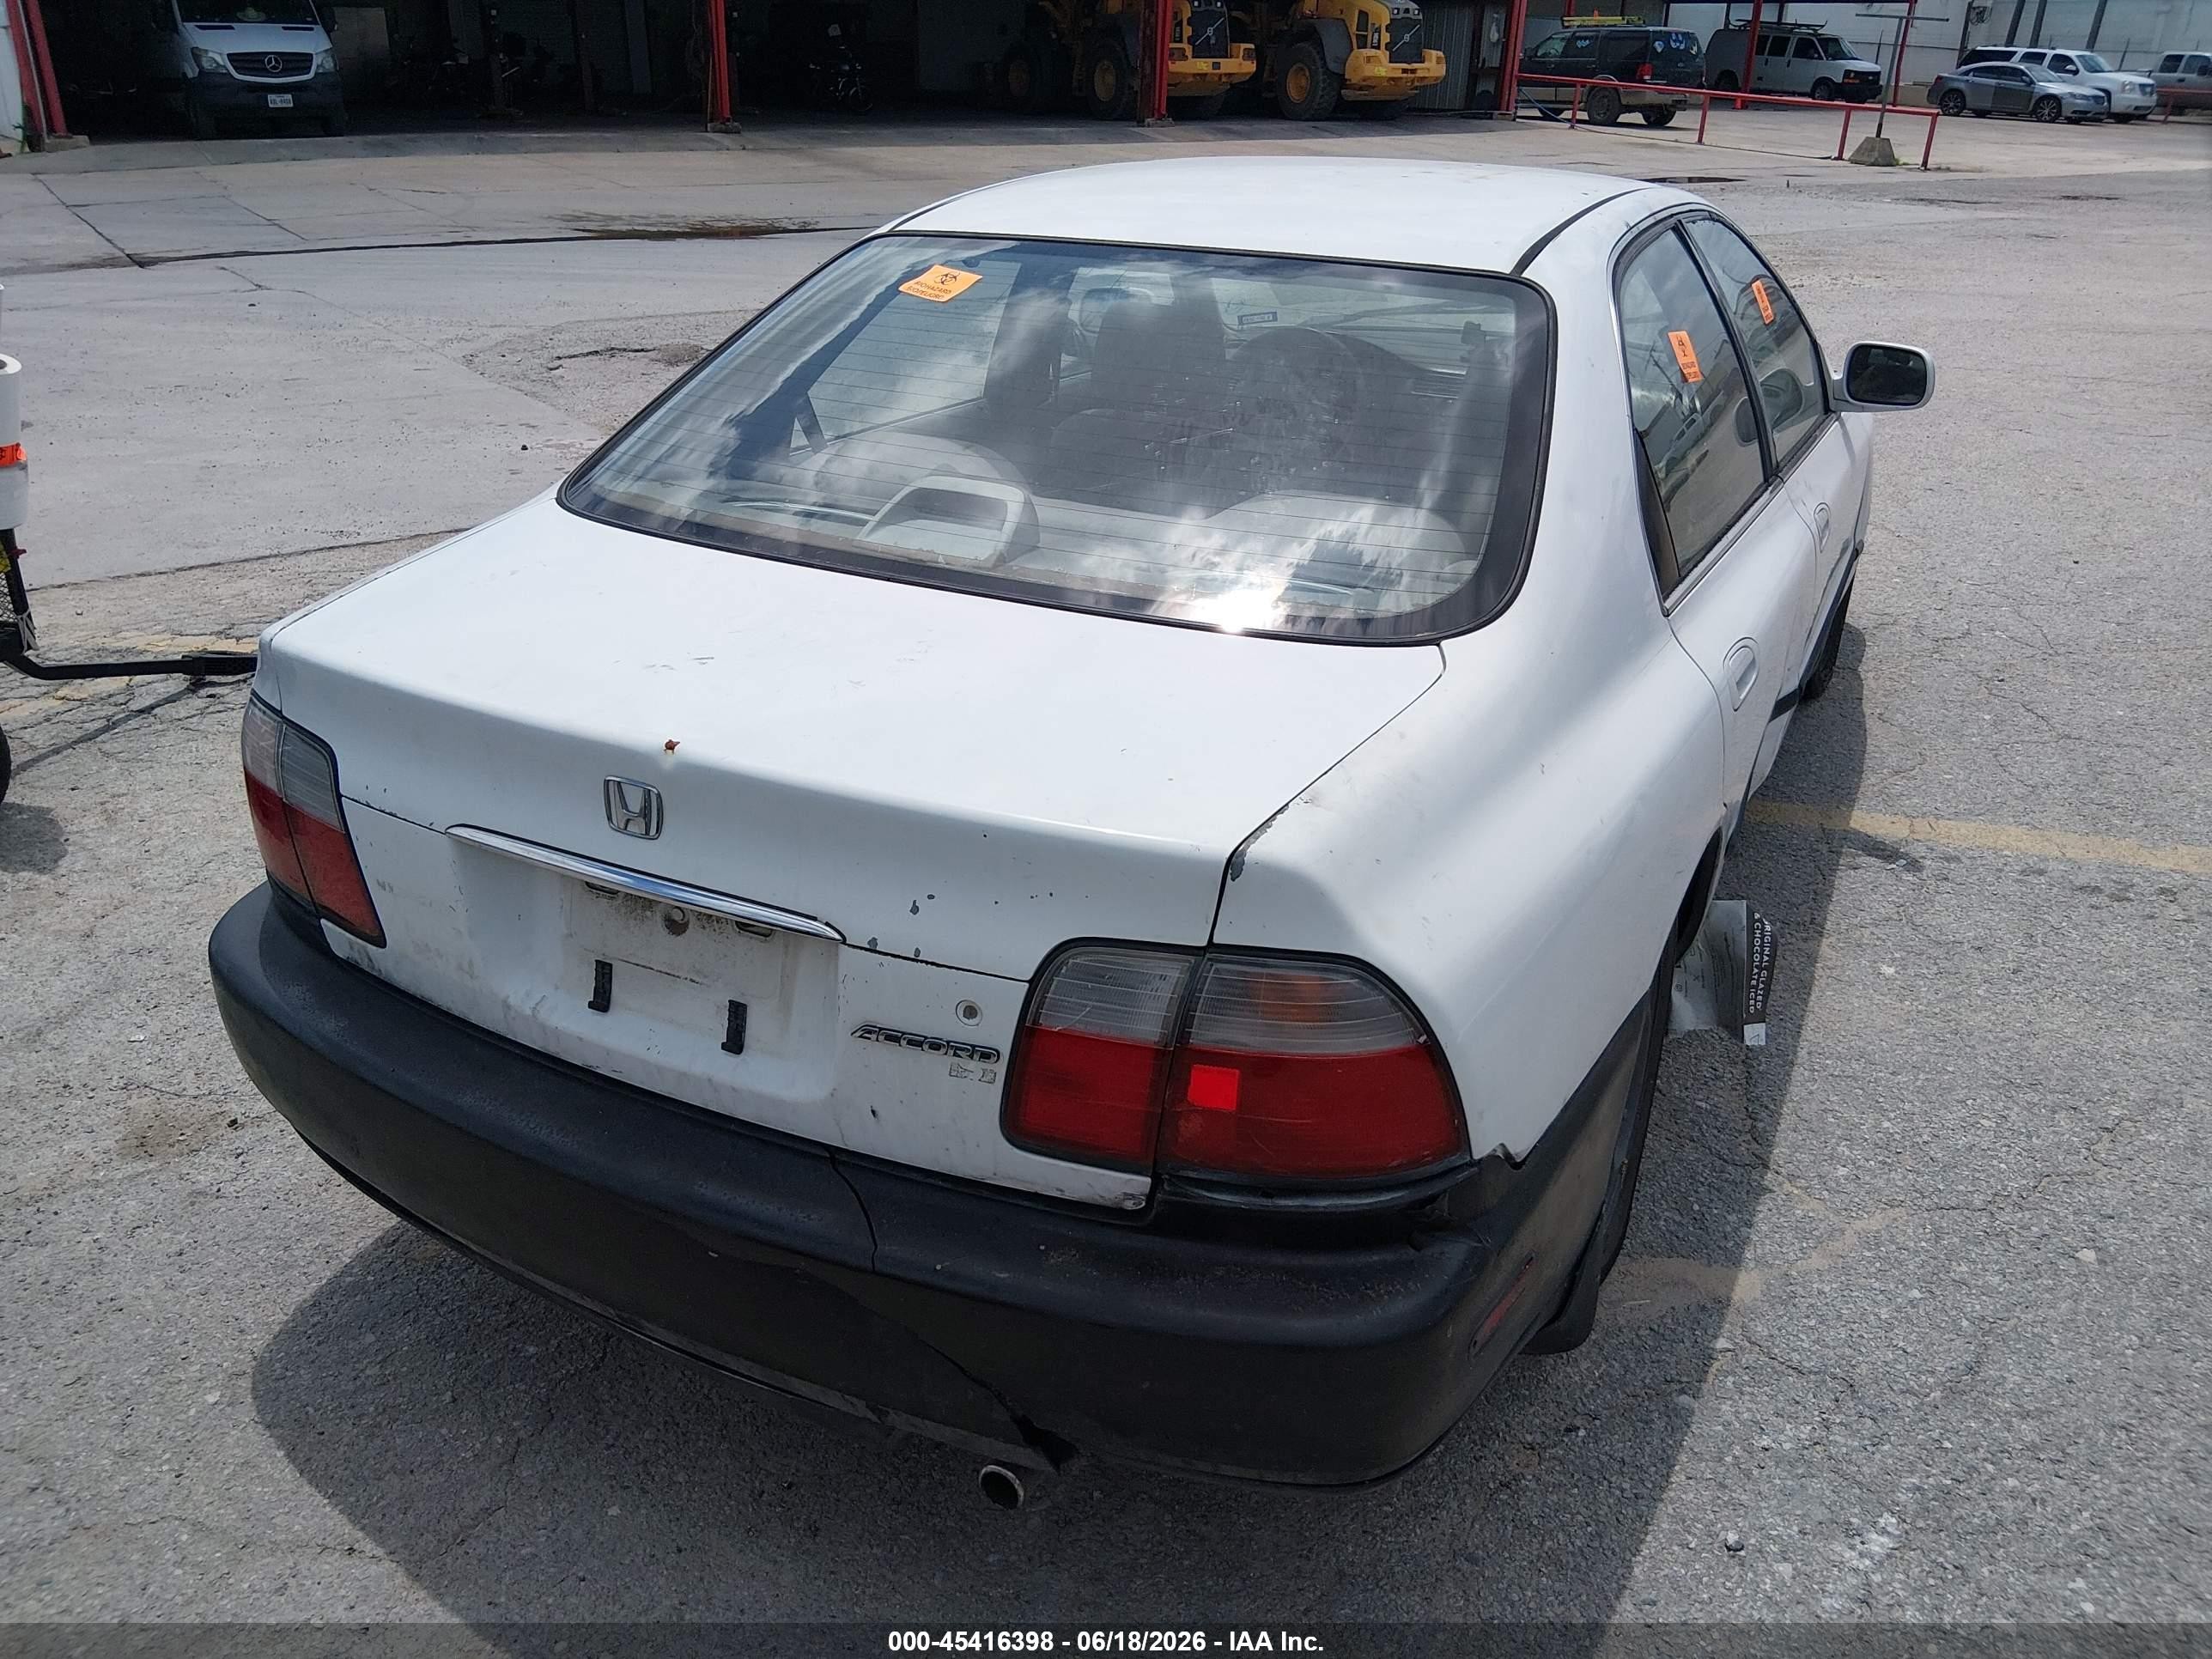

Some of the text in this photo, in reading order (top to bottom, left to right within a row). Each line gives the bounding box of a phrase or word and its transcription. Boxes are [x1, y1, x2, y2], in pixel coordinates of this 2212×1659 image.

[914, 281, 951, 295] BIOHAZARD
[1750, 921, 1761, 986] CHOCOLATE
[1756, 969, 1767, 1010] GLAZED
[851, 1022, 1002, 1064] ACCORD
